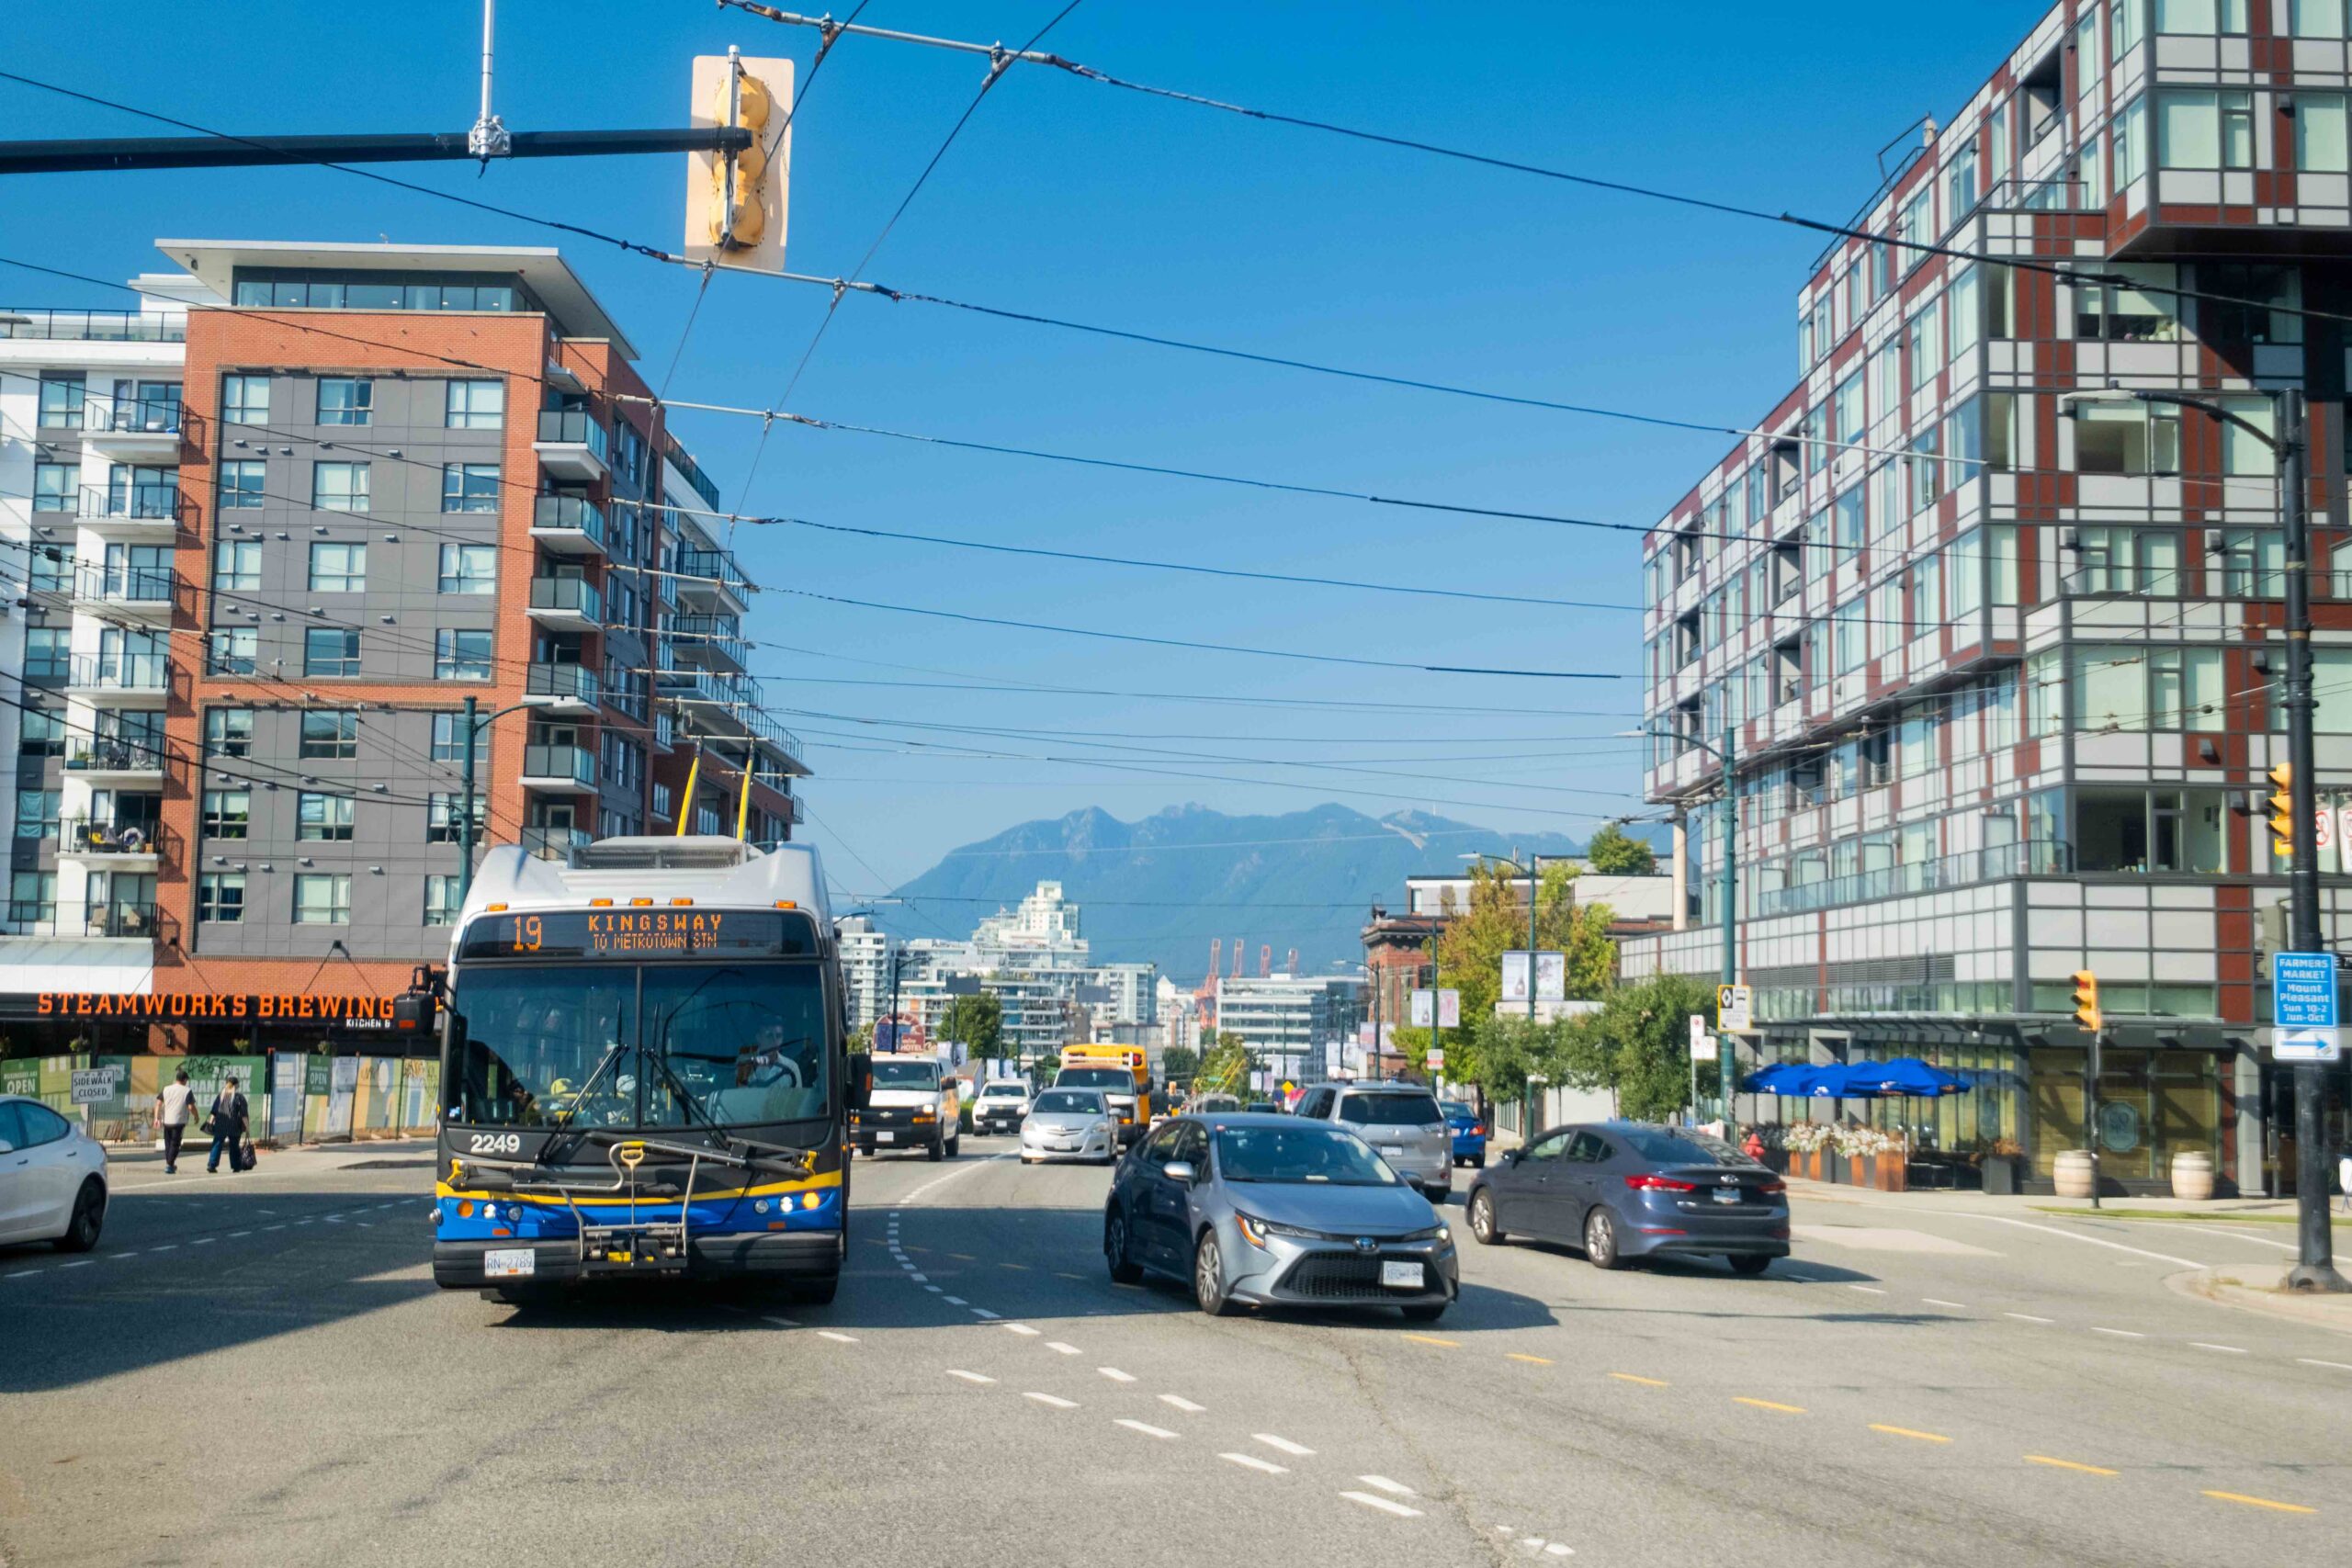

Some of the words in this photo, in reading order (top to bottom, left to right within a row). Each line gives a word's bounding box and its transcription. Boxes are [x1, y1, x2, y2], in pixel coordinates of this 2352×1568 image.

[514, 916, 542, 951] 19
[589, 914, 722, 931] KINGSWAY
[594, 933, 607, 950] TO
[614, 933, 686, 950] METROTOWN
[694, 932, 718, 949] STN
[2279, 958, 2328, 968] FARMERS
[2283, 970, 2325, 979] MARKET
[2288, 984, 2323, 993] Mount
[2279, 993, 2330, 1003] Pleasant
[38, 992, 247, 1017] STEAMWORKS
[258, 993, 394, 1020] BREWING
[2283, 1003, 2301, 1012] Sun
[2307, 1004, 2327, 1013] 10-2
[2286, 1013, 2325, 1022] Jun-Oct
[346, 1019, 380, 1028] KITCHEN
[74, 1076, 112, 1087] SIDEWALK
[309, 1072, 327, 1086] OPEN
[6, 1078, 36, 1095] OPEN
[78, 1088, 107, 1098] CLOSED
[470, 1134, 521, 1154] 2249
